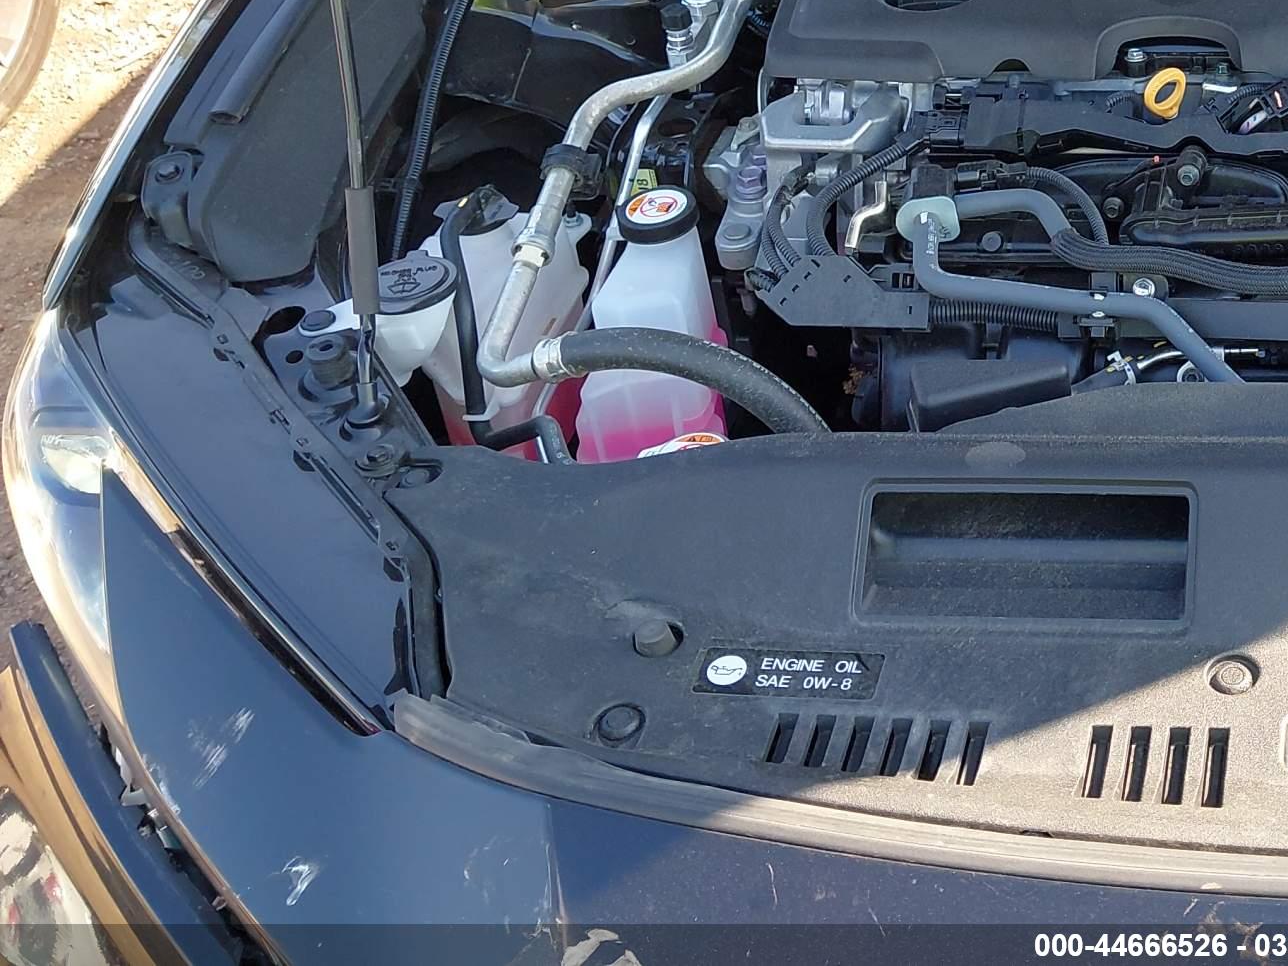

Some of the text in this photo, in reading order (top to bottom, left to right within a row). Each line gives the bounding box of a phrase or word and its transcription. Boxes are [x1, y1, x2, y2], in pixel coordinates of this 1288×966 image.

[761, 657, 863, 674] ENGINE OIL
[755, 674, 852, 691] SAE 0W-8
